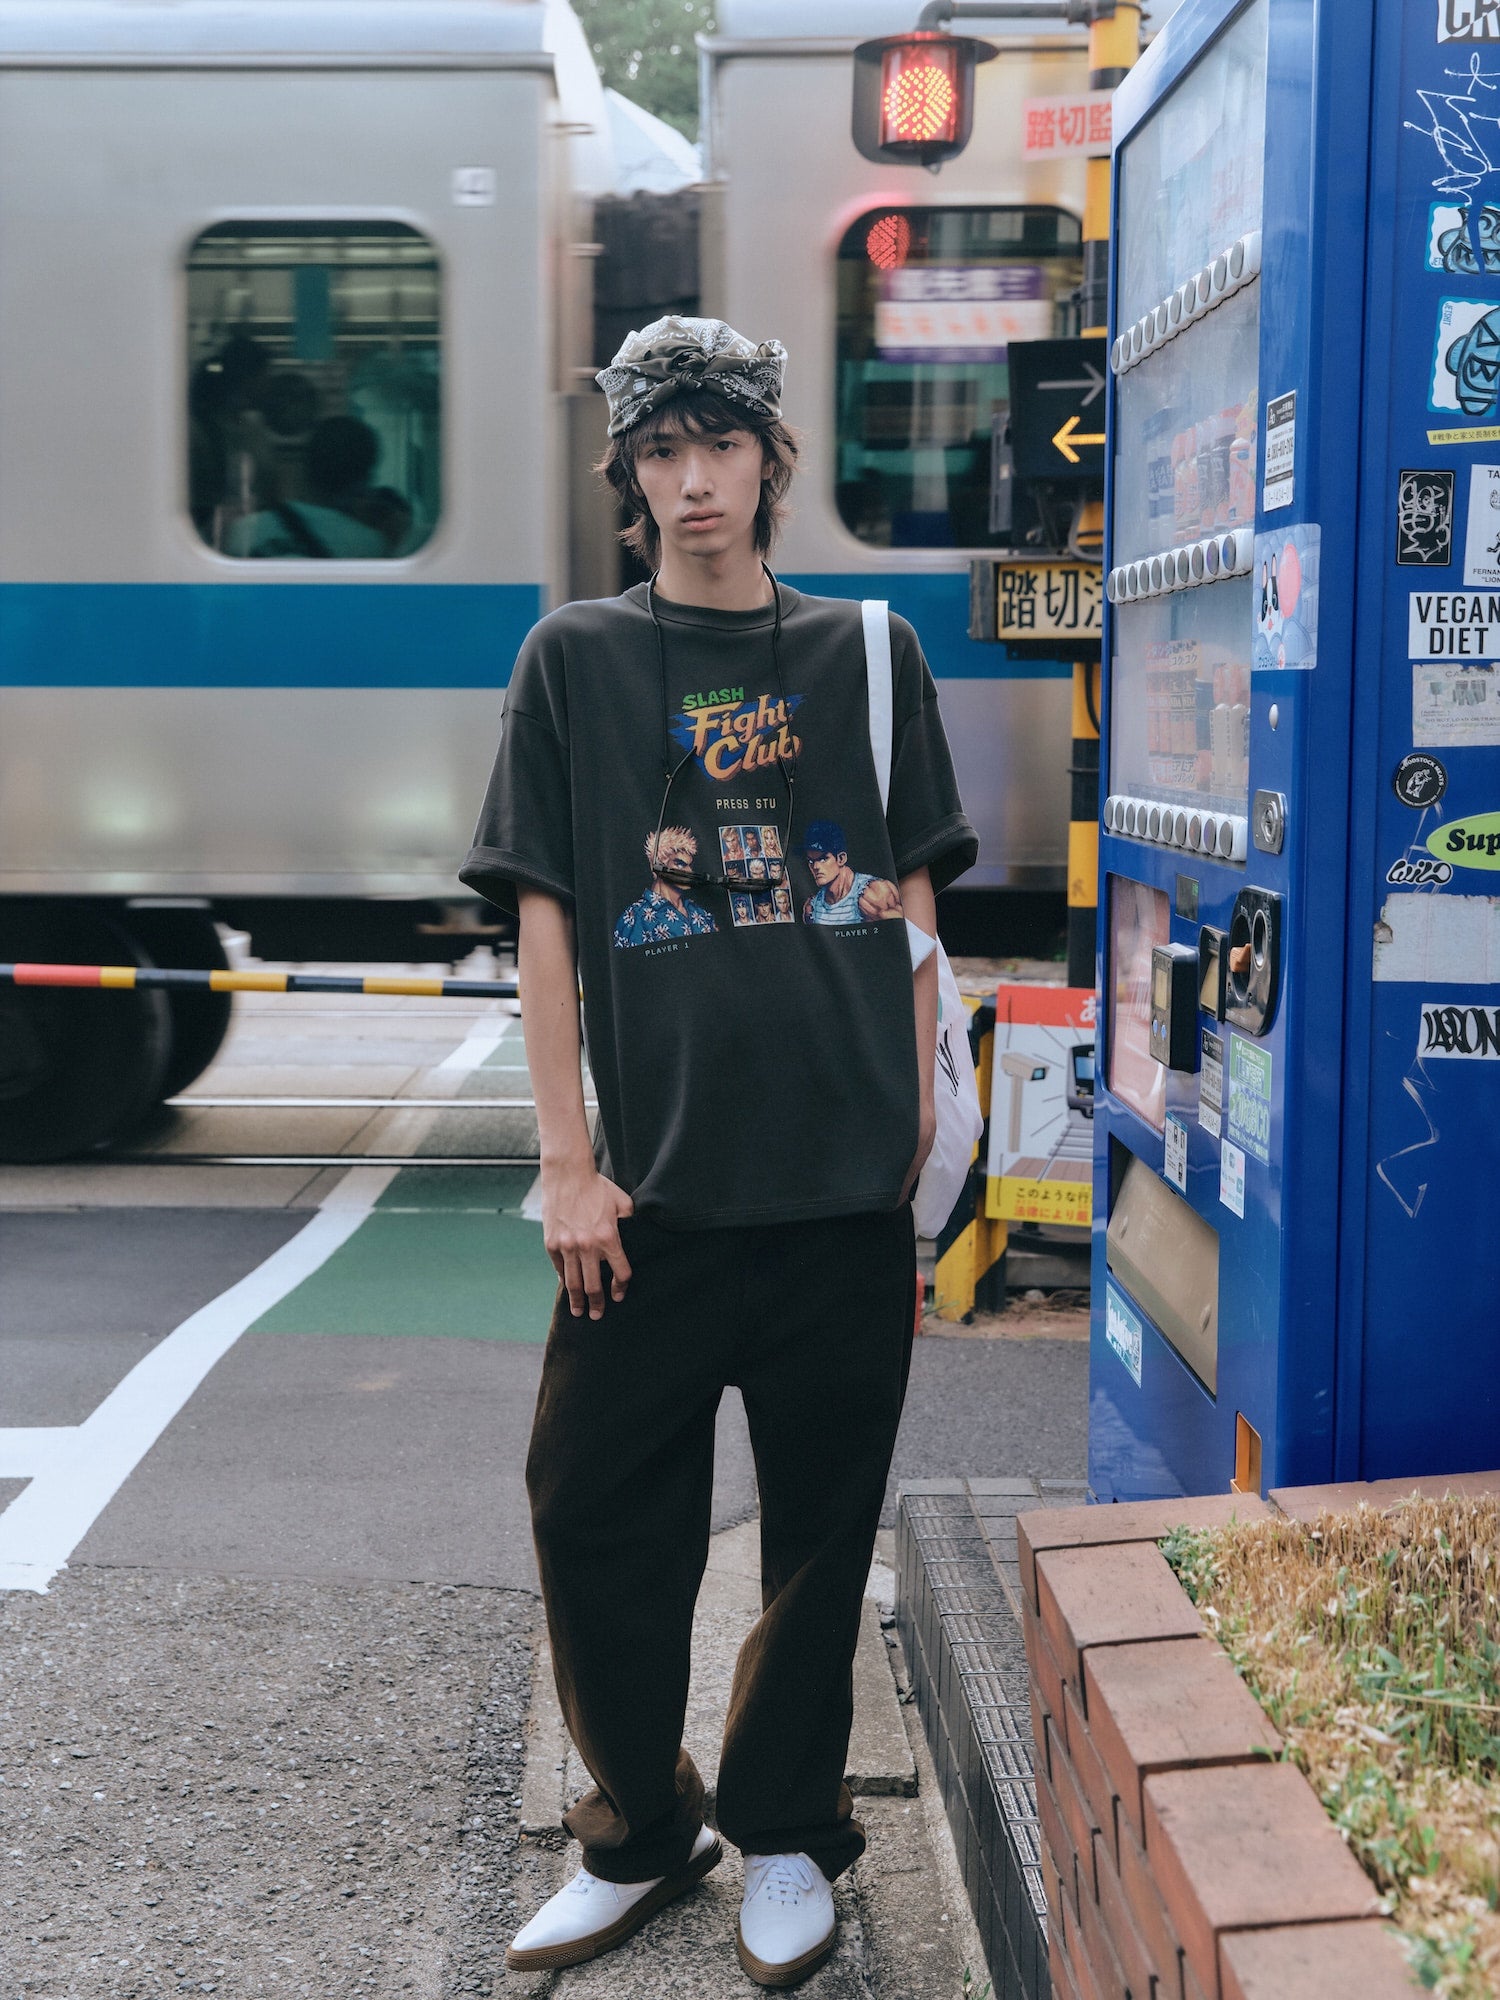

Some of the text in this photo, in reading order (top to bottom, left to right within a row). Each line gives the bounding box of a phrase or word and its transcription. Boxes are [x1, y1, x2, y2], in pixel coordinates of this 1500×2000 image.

[1432, 428, 1500, 441] #戦争と家父長制を
[1416, 596, 1500, 624] VEGAN
[1429, 627, 1489, 654] DIET
[682, 687, 745, 710] SLASH
[684, 694, 793, 756] Fight
[704, 724, 803, 783] Club
[716, 798, 776, 810] PRESS STU
[1446, 828, 1500, 855] Sup
[835, 928, 868, 937] PLAYER
[645, 944, 678, 956] PLAYER
